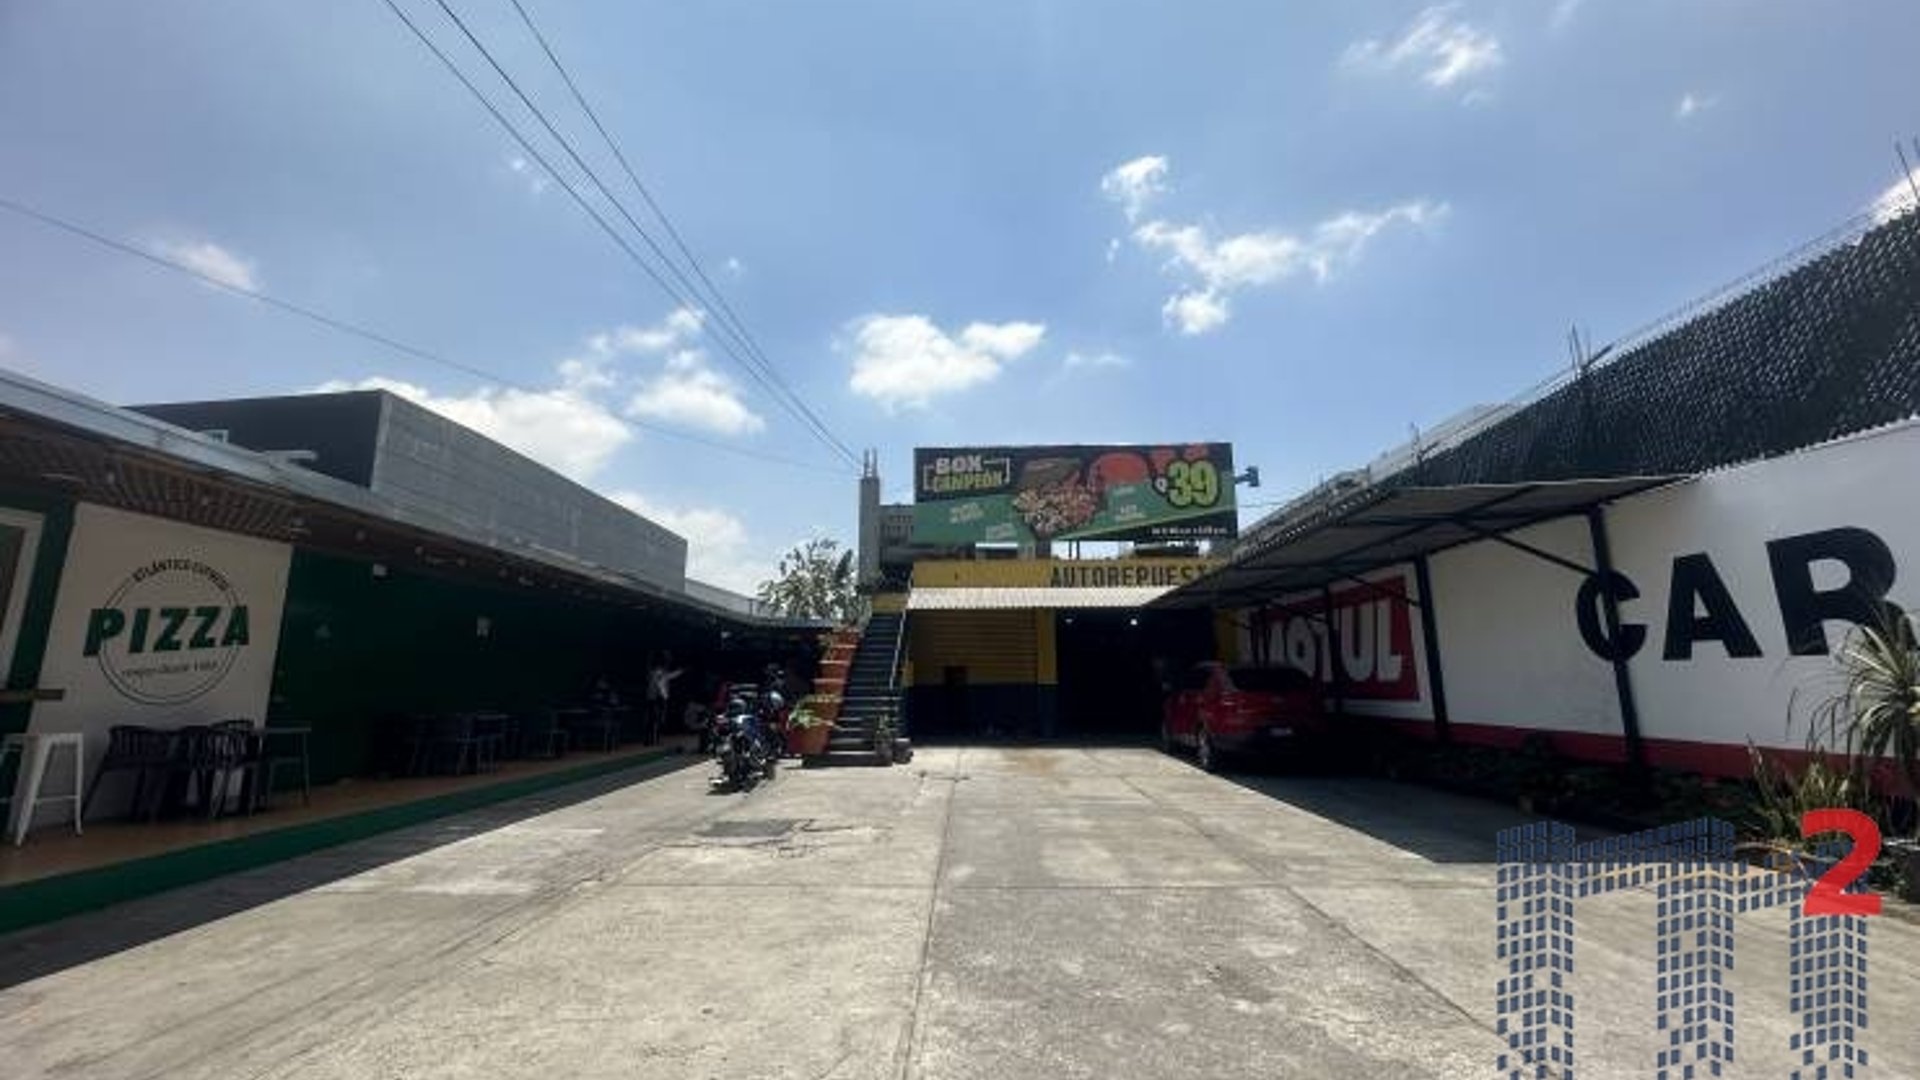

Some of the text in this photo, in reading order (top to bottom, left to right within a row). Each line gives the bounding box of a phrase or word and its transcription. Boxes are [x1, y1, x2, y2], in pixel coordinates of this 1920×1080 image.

[935, 455, 982, 475] BOX
[1575, 526, 1920, 662] CAR
[83, 605, 250, 658] PIZZA
